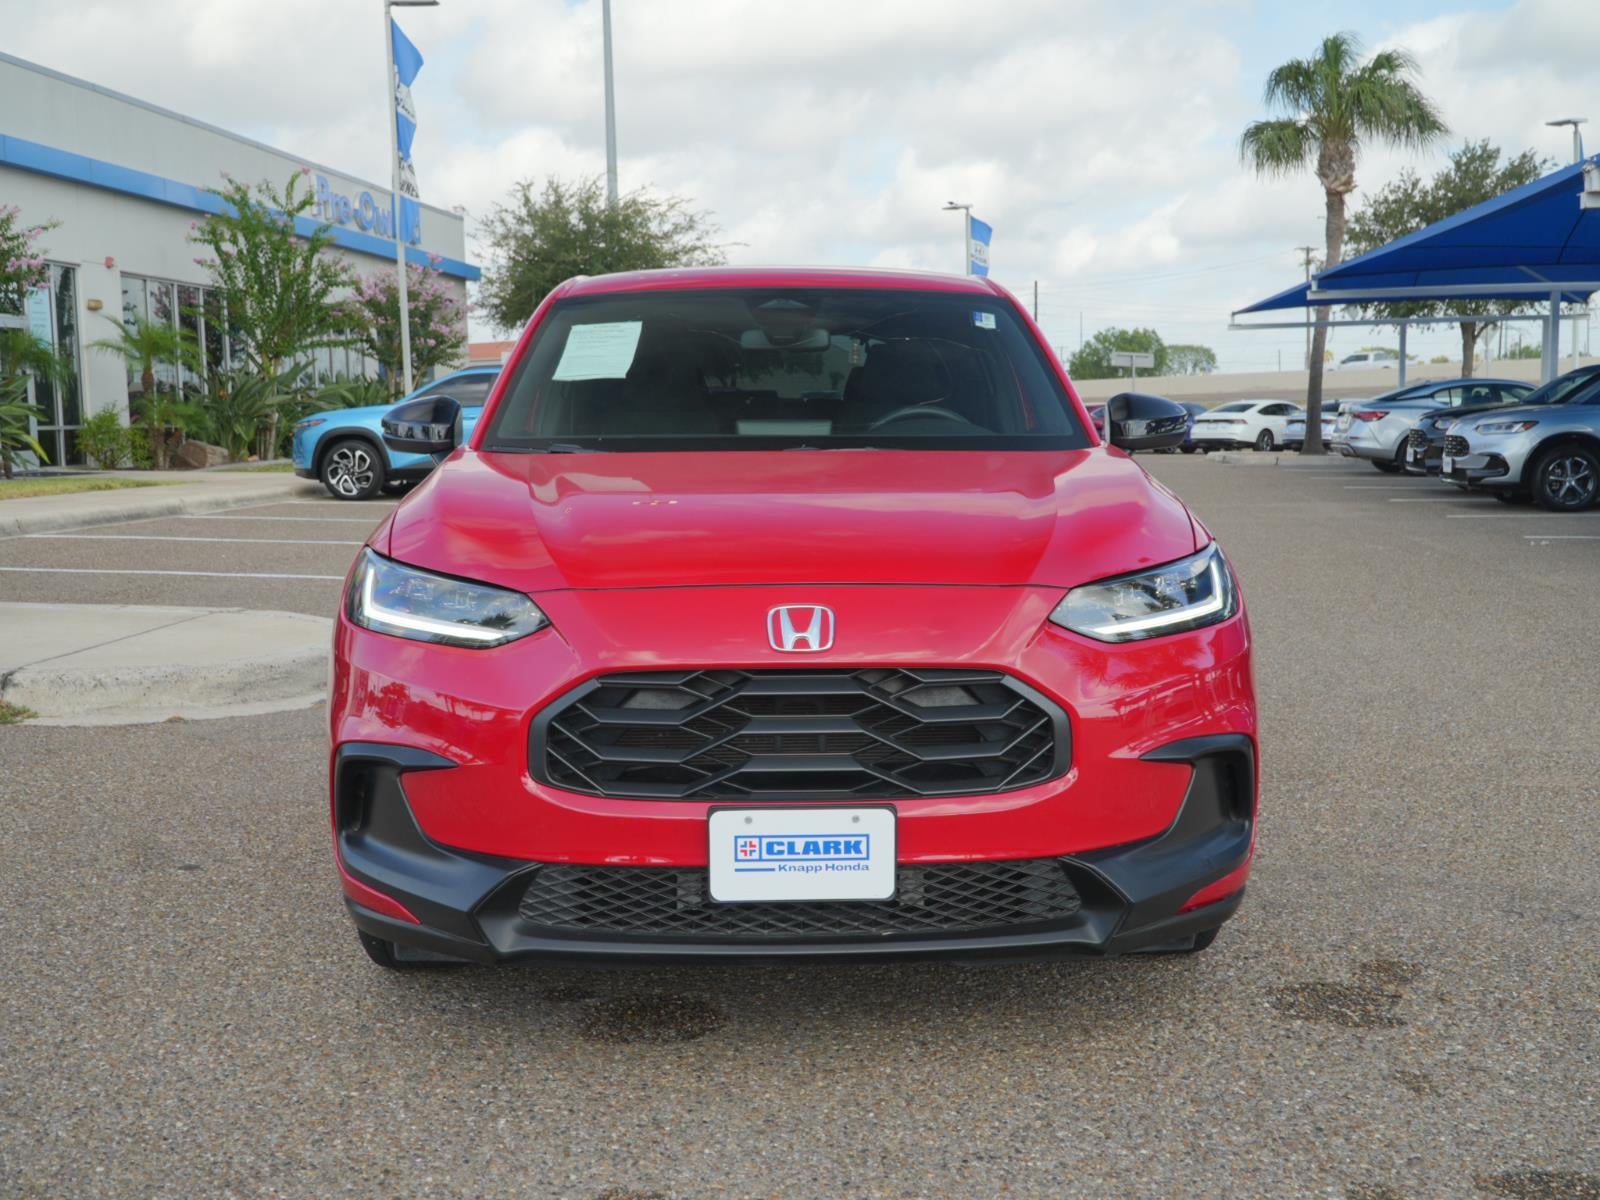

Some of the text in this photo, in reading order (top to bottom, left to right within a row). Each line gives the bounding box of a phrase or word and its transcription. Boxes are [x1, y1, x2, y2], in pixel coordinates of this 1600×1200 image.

[312, 175, 391, 238] Pre-Ow
[765, 840, 864, 856] CLARK
[778, 863, 870, 874] Knapp Honda
